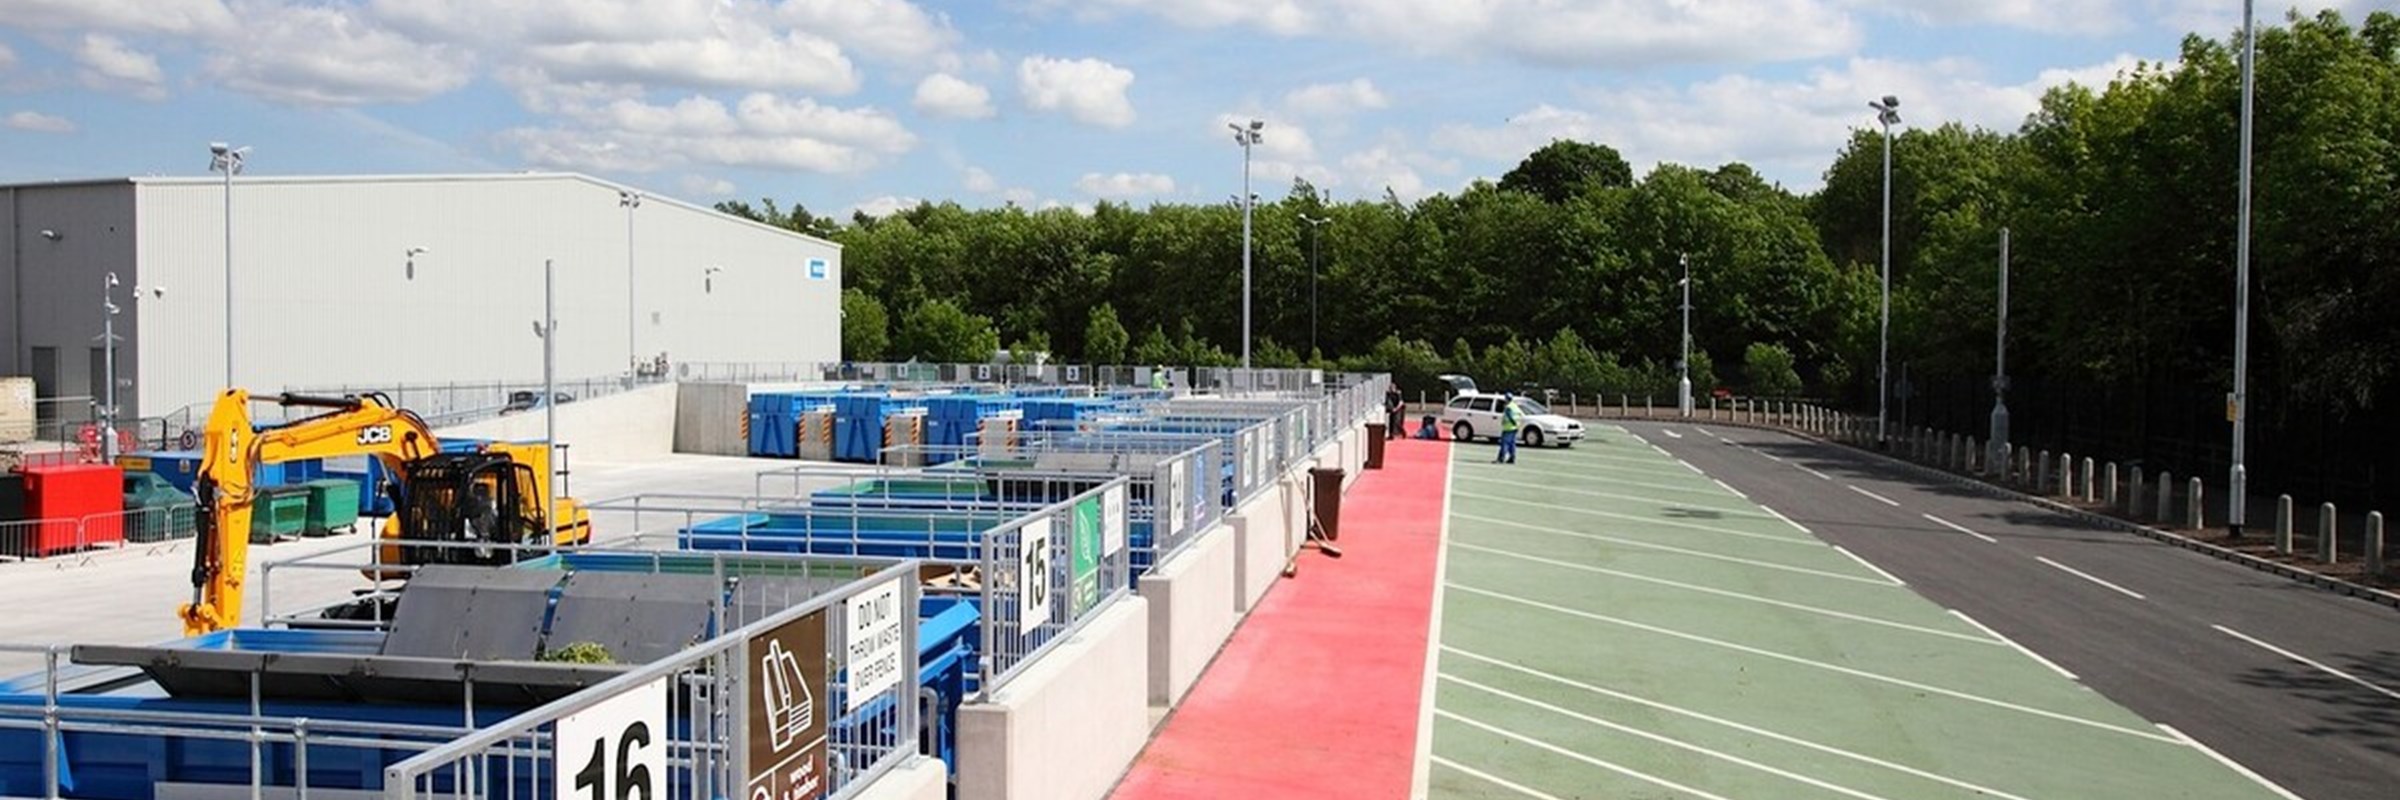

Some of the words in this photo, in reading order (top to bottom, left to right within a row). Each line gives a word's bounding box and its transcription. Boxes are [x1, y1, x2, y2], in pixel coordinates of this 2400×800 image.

[358, 426, 392, 444] JCB
[1026, 537, 1046, 610] 15
[858, 601, 872, 630] DO
[874, 592, 890, 622] NOT
[575, 720, 652, 800] 16
[789, 755, 813, 783] wood
